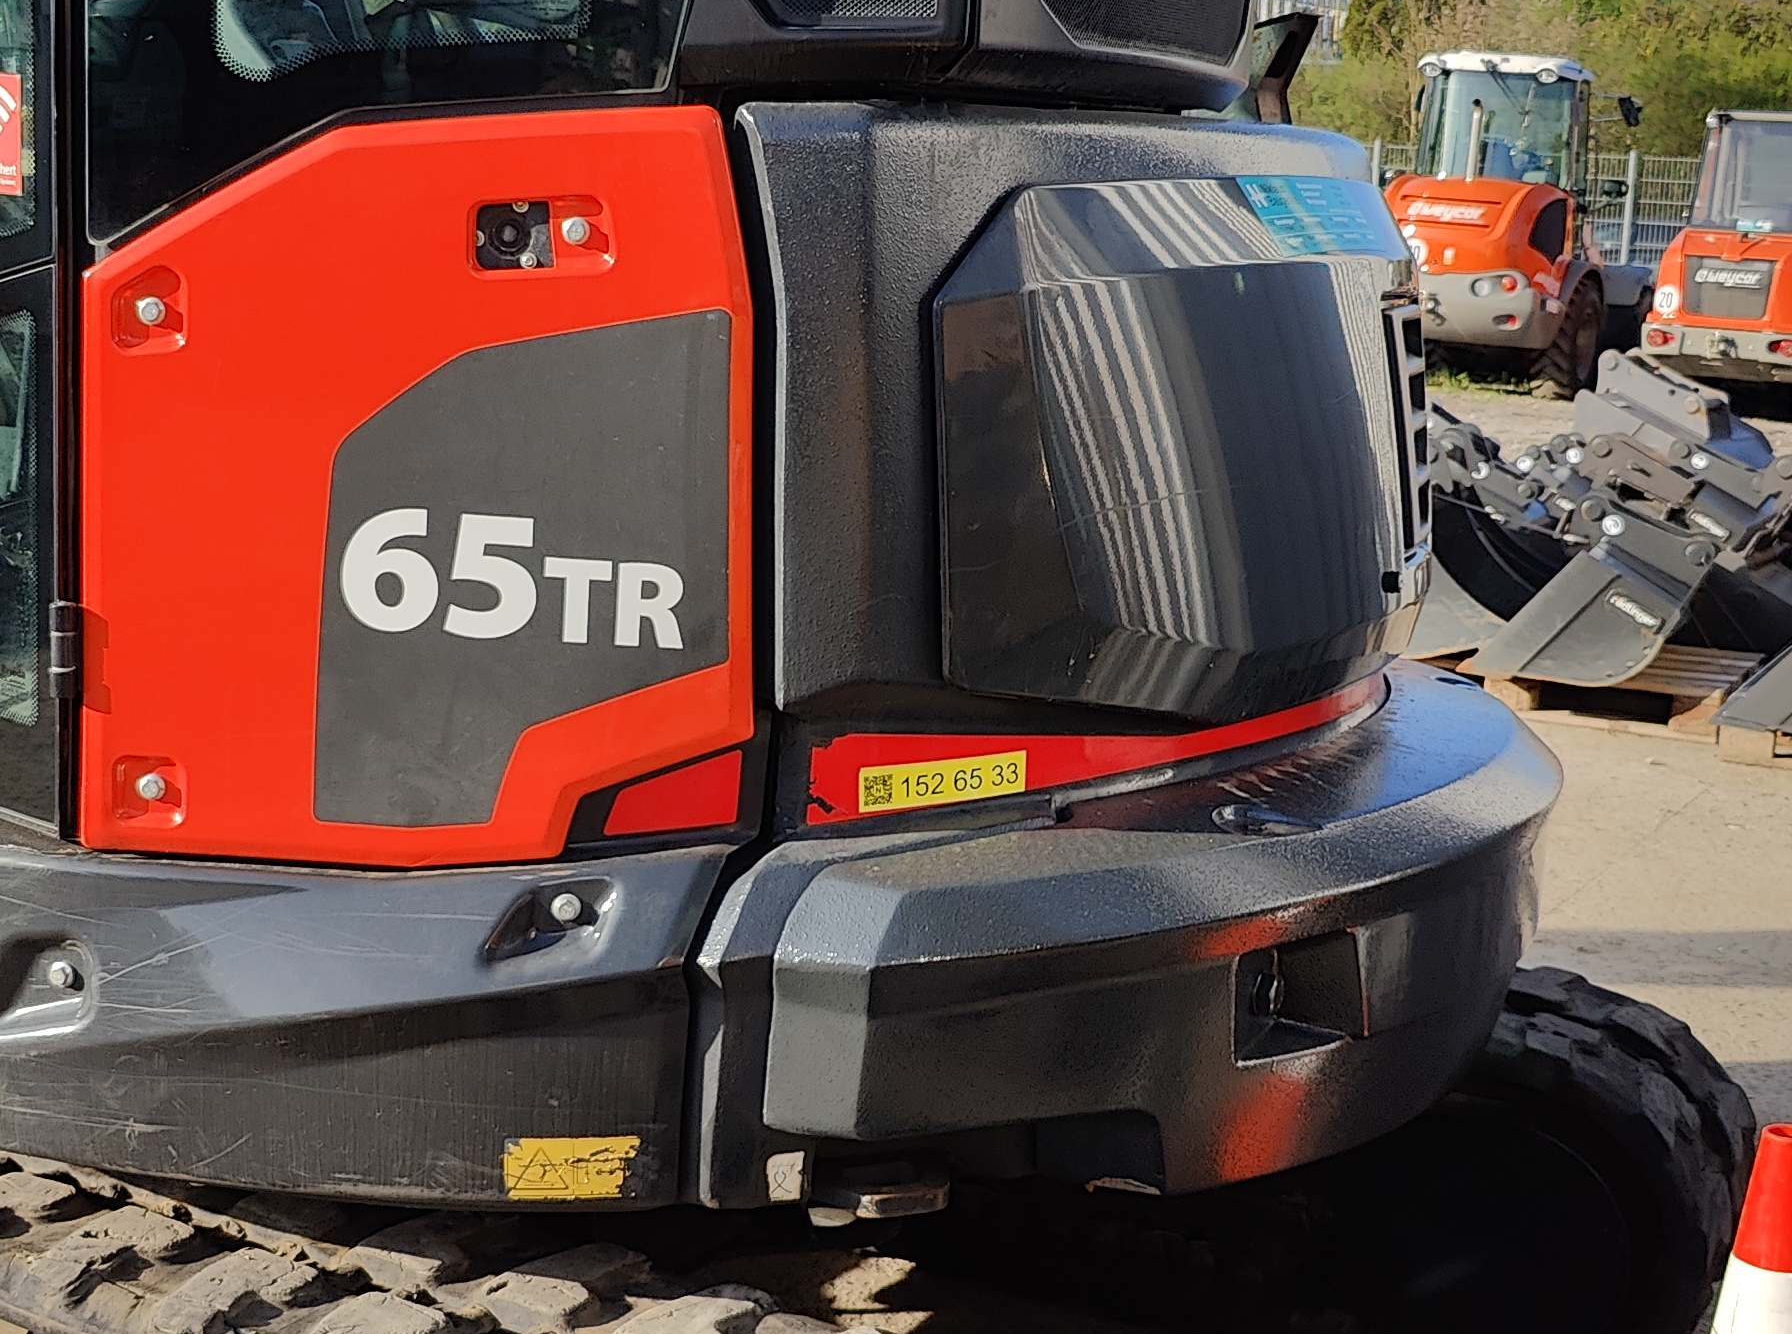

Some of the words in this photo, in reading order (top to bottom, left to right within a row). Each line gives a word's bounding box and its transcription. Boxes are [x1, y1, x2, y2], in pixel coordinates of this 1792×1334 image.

[1659, 291, 1674, 309] 20
[900, 772, 944, 798] 152
[953, 768, 982, 792] 65
[991, 762, 1019, 787] 33
